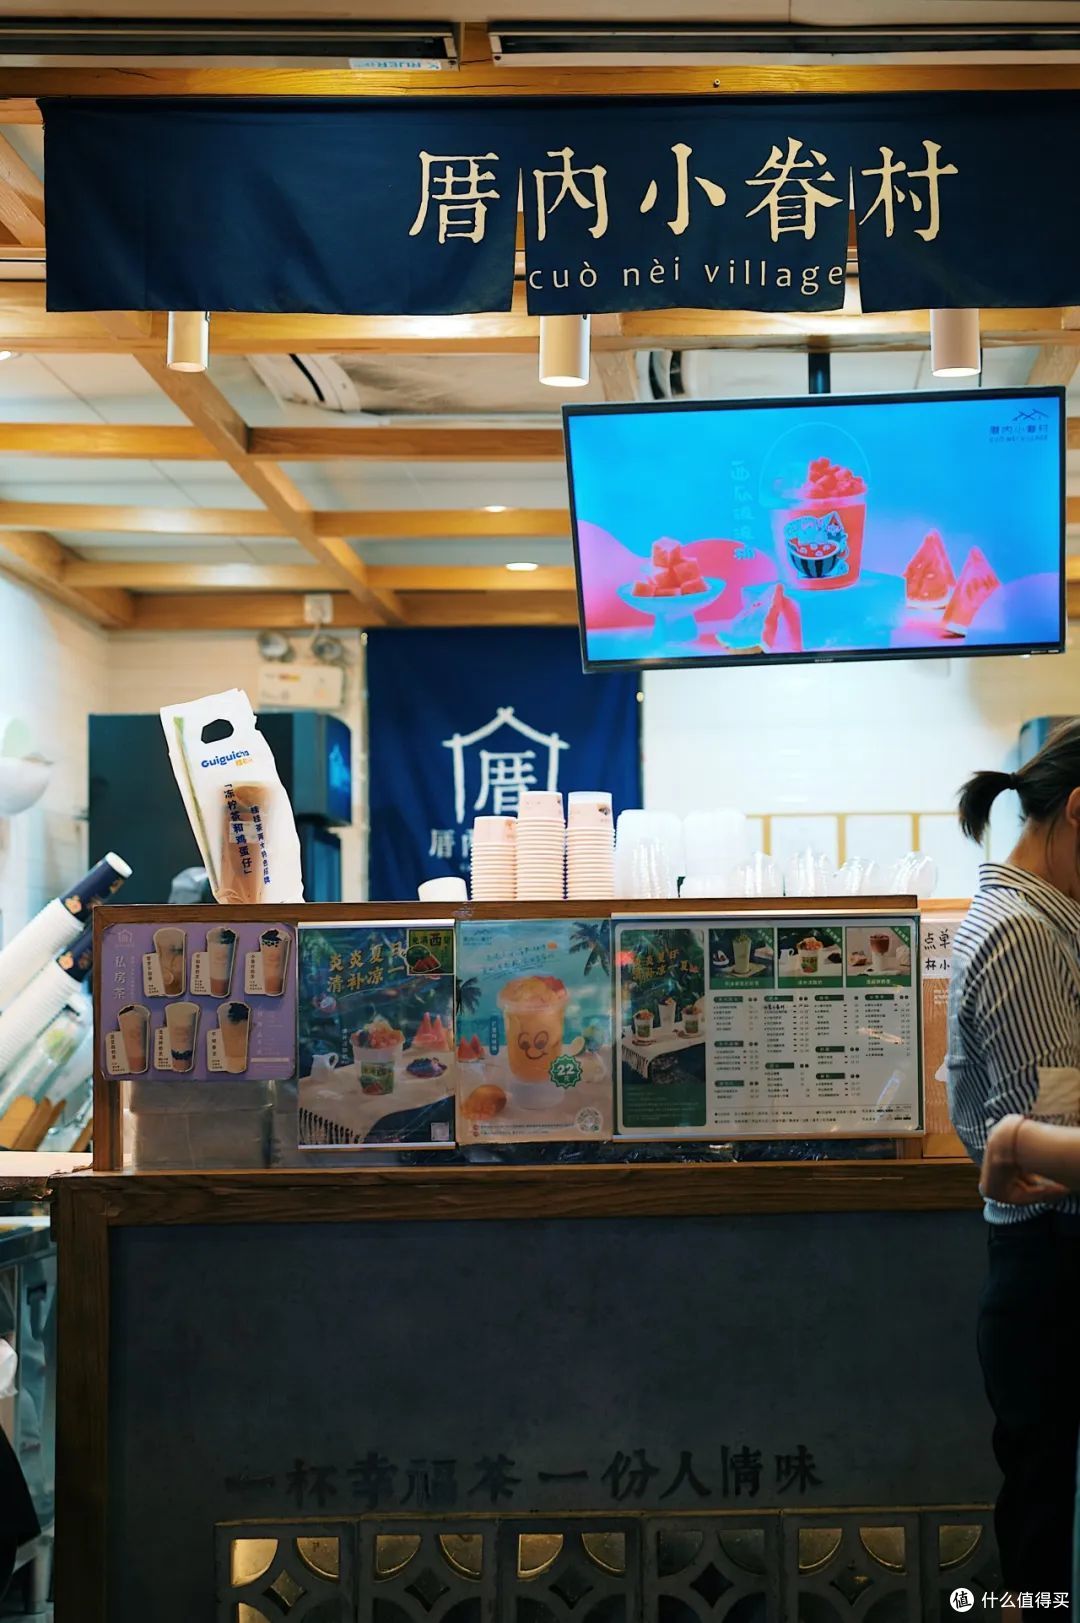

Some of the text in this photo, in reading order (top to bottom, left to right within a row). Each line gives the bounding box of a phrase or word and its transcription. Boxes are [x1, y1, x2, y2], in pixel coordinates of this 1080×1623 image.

[409, 136, 958, 243] 厝內小眷村
[529, 256, 845, 295] cuò nèi village
[556, 1064, 575, 1077] 22
